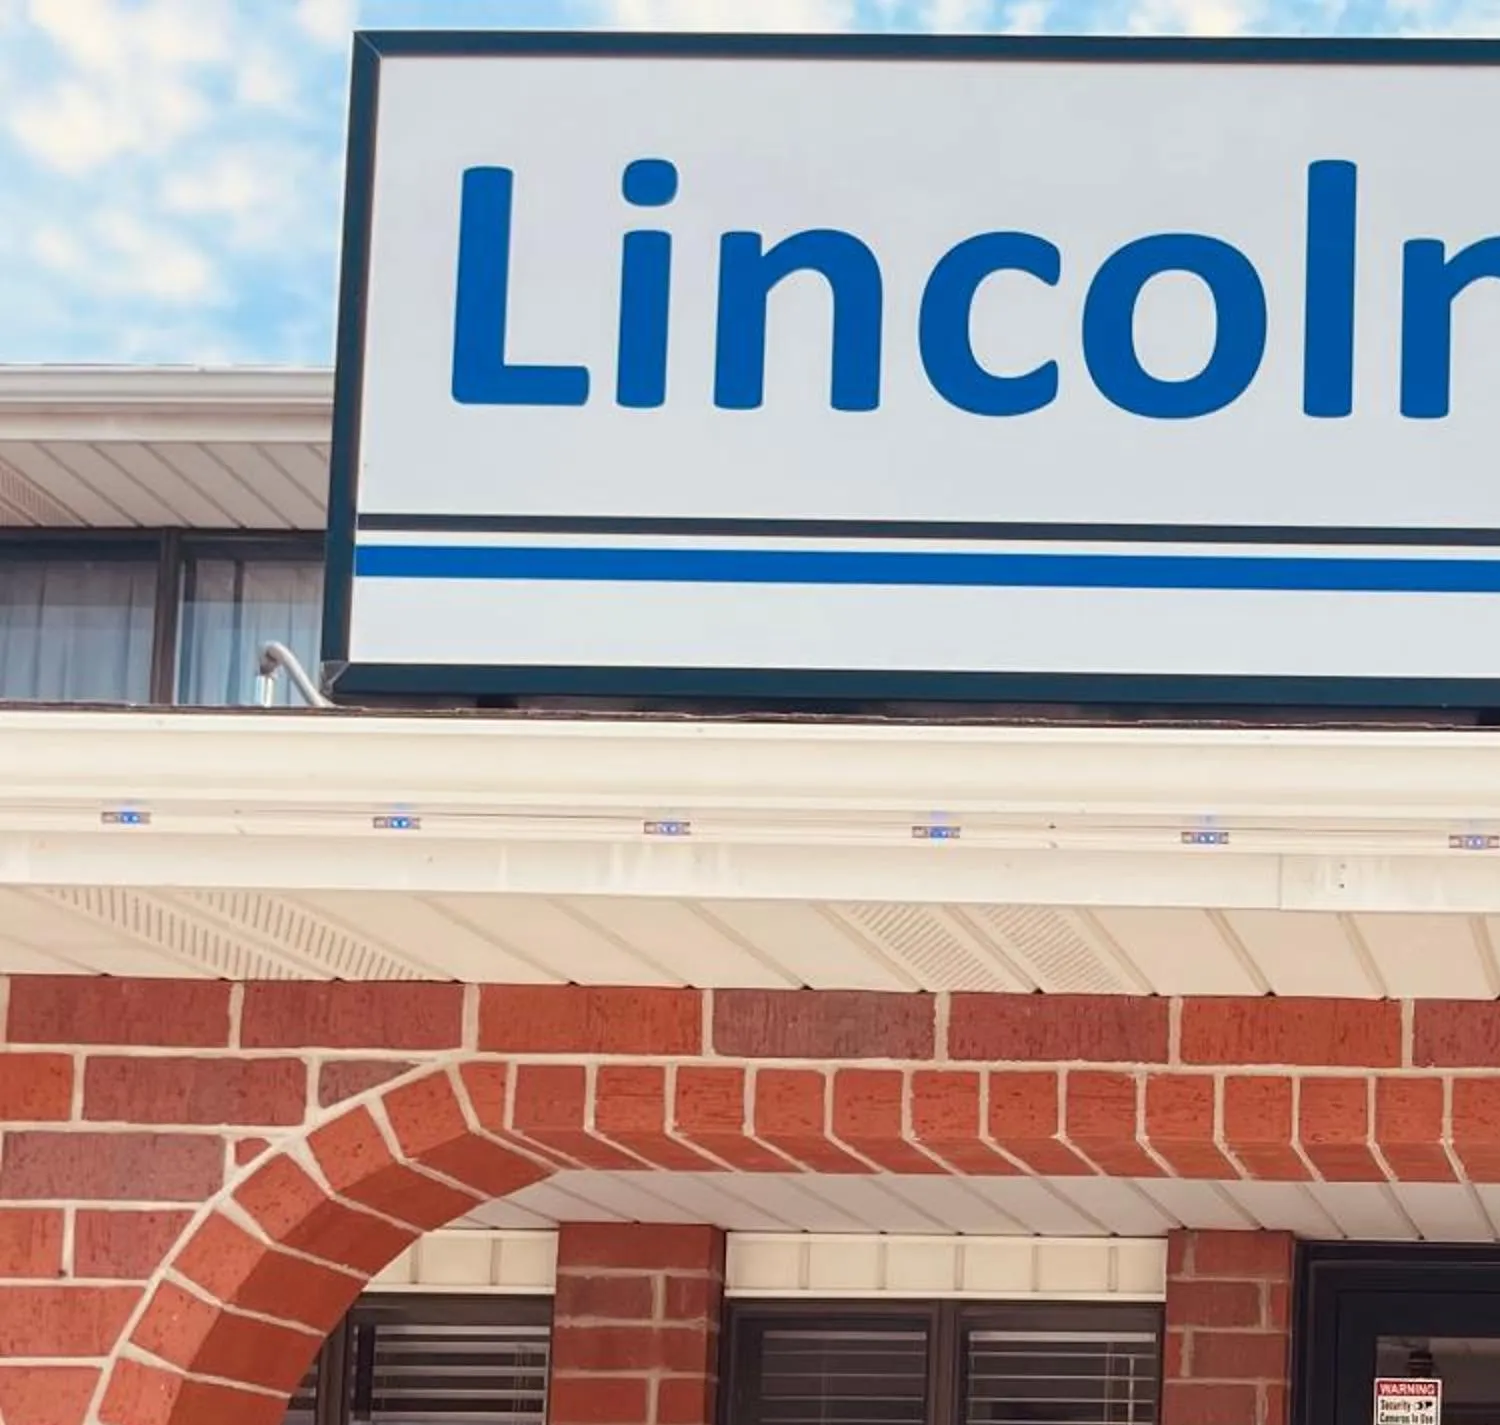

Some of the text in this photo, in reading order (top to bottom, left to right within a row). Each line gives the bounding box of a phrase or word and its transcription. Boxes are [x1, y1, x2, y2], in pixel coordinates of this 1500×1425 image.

[1379, 1383, 1435, 1395] WARNING
[1380, 1399, 1411, 1412] Security
[1380, 1413, 1410, 1424] Cameras
[1421, 1413, 1433, 1424] Use
